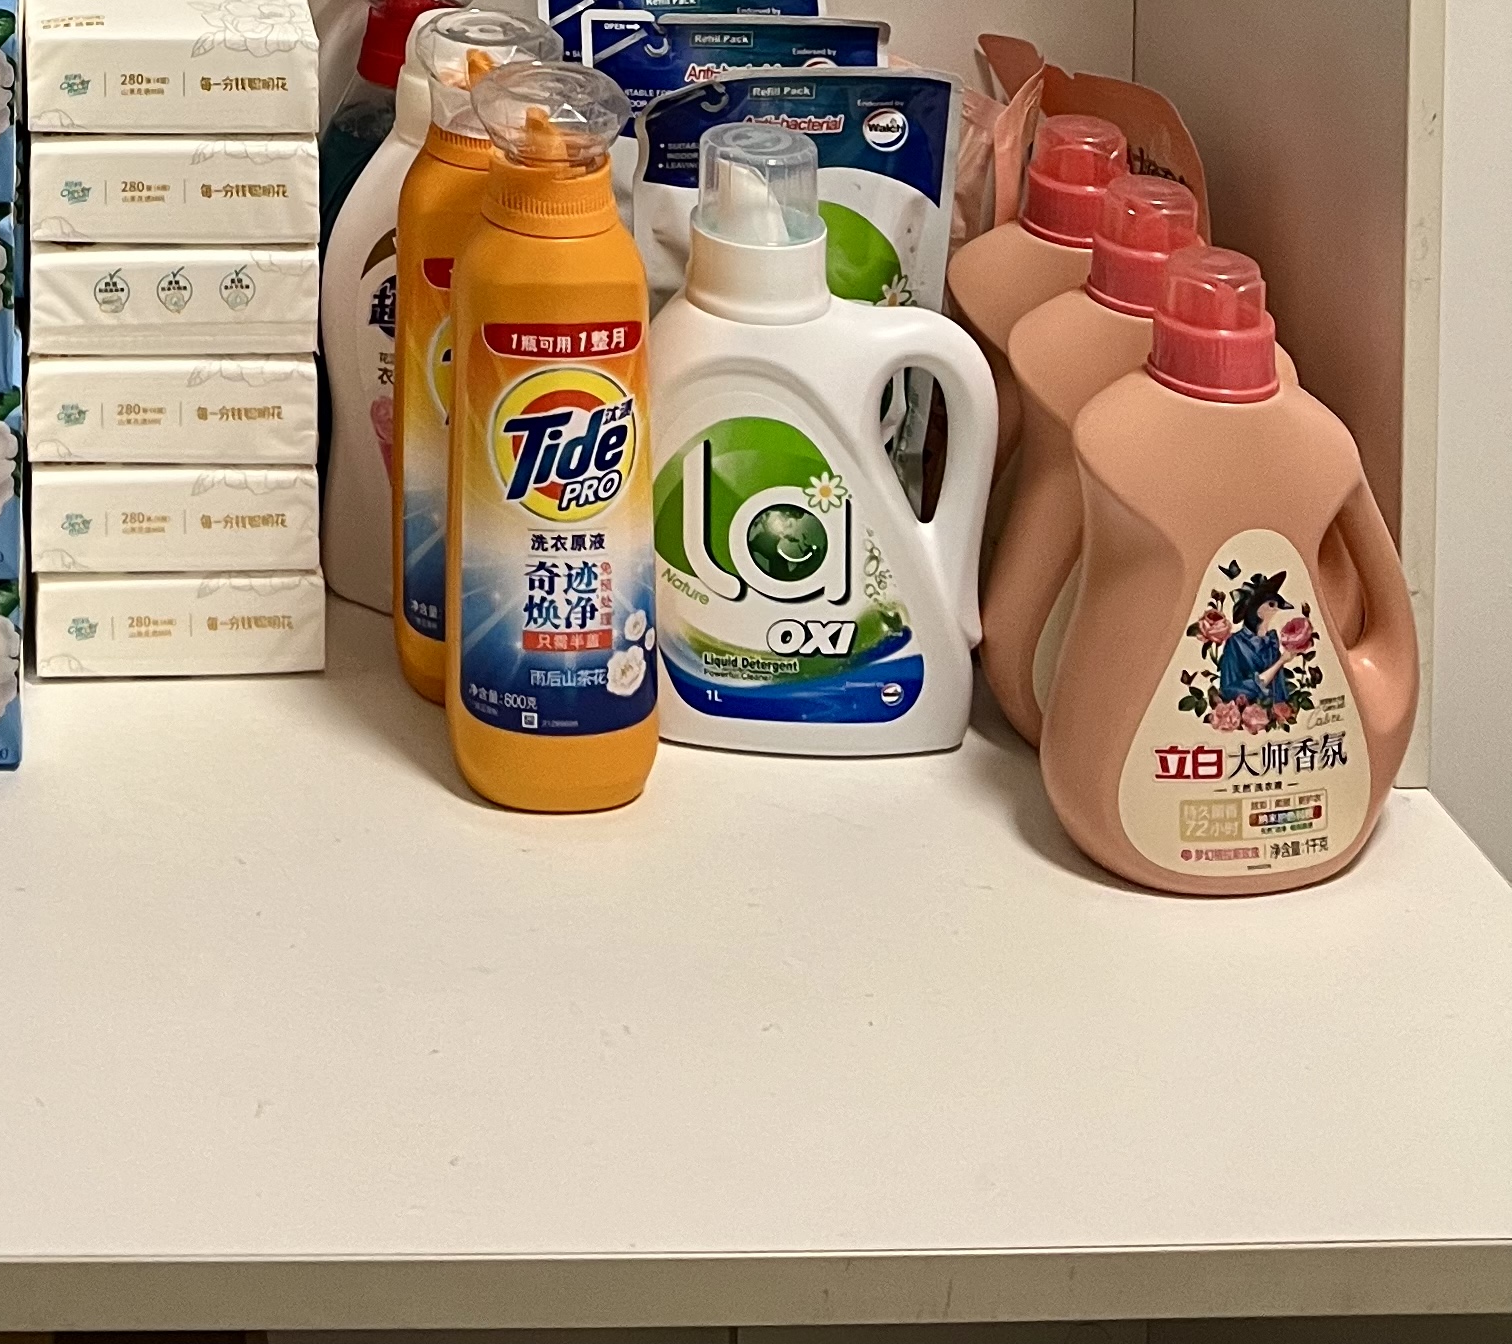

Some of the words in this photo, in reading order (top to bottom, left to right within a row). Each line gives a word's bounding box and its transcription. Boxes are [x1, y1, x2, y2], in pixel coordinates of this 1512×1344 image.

[723, 34, 749, 44] Pack
[752, 87, 781, 97] Refill
[783, 87, 811, 96] Pack
[503, 409, 629, 501] Tide
[559, 470, 622, 511] PRO
[530, 532, 607, 553] 洗衣原液
[523, 560, 599, 596] 奇迹
[660, 566, 711, 606] Nature
[522, 596, 599, 630] 焕净
[766, 618, 858, 658] OXI
[529, 669, 608, 688] 雨后山茶花
[703, 651, 739, 671] Liquid
[740, 656, 799, 674] Detergent
[705, 689, 723, 703] 1L
[1153, 744, 1225, 781] 立白
[1227, 730, 1348, 780] 大师香氛
